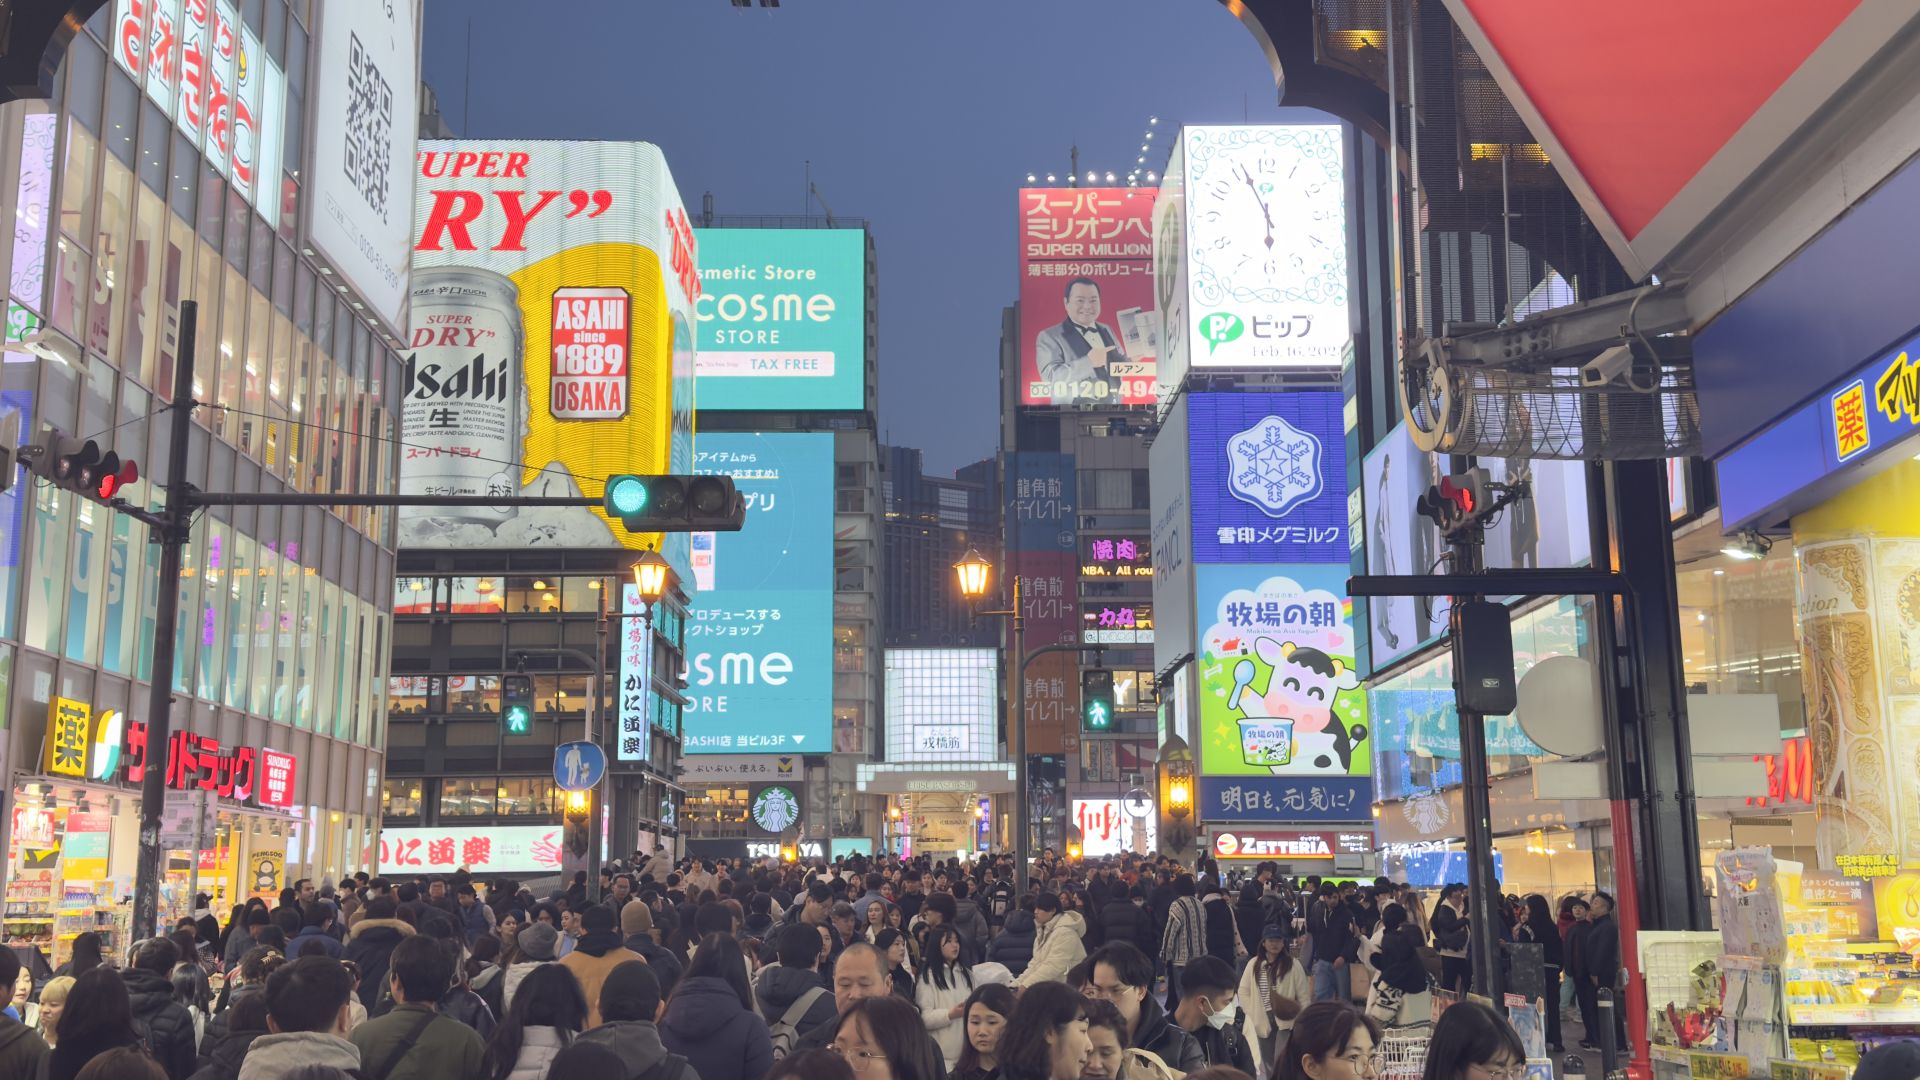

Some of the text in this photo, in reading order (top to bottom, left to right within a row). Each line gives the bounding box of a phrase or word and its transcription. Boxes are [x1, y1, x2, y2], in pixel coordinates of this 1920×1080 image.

[415, 151, 530, 178] UPER
[1026, 191, 1122, 216] スーパー
[1027, 243, 1152, 257] SUPER MILLION
[764, 264, 817, 281] Store
[555, 300, 624, 330] ASAHI
[695, 293, 836, 322] cosme
[426, 314, 474, 325] SUPER
[1252, 314, 1315, 339] ピップ
[573, 331, 606, 343] since
[715, 330, 780, 344] STORE
[554, 344, 624, 376] 1889
[750, 358, 779, 370] TAX
[784, 358, 819, 370] FREE
[1113, 365, 1145, 375] ルアン
[555, 381, 622, 412] OSAKA
[429, 408, 460, 429] 生
[1836, 391, 1865, 453] 薬
[1016, 478, 1063, 498] 龍角散
[1009, 500, 1062, 520] ダイレクト
[1216, 526, 1340, 544] 雪印メグミルク
[1093, 538, 1137, 561] 焼肉
[1115, 566, 1132, 576] All
[1226, 601, 1336, 627] 牧場の朝
[55, 703, 84, 768] 薬
[736, 735, 786, 747] 当ビル3F
[127, 720, 257, 800] サドラッグ
